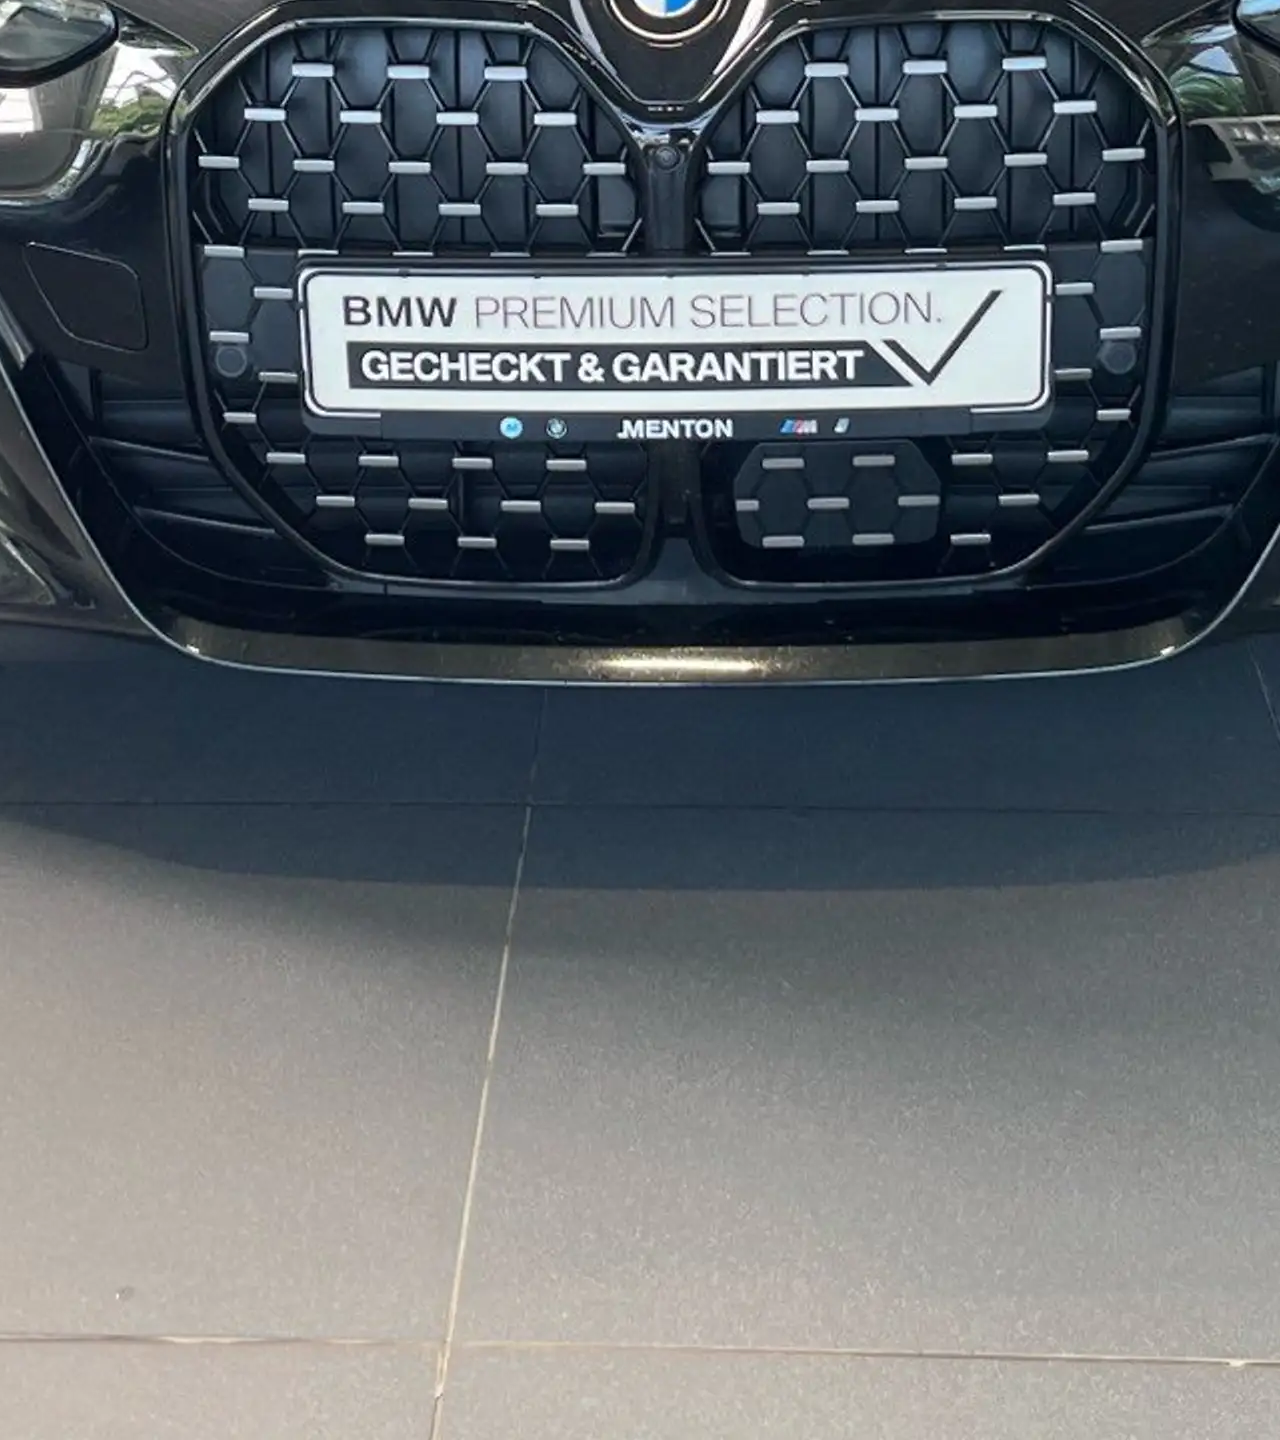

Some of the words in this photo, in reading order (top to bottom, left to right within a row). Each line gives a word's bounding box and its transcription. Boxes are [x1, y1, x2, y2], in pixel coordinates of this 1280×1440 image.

[342, 295, 457, 328] BMW
[475, 295, 674, 329] PREMIUM
[690, 291, 942, 328] SELECTION.
[361, 350, 571, 382] GECHECKT
[577, 351, 605, 383] &
[611, 349, 865, 383] GARANTIERT
